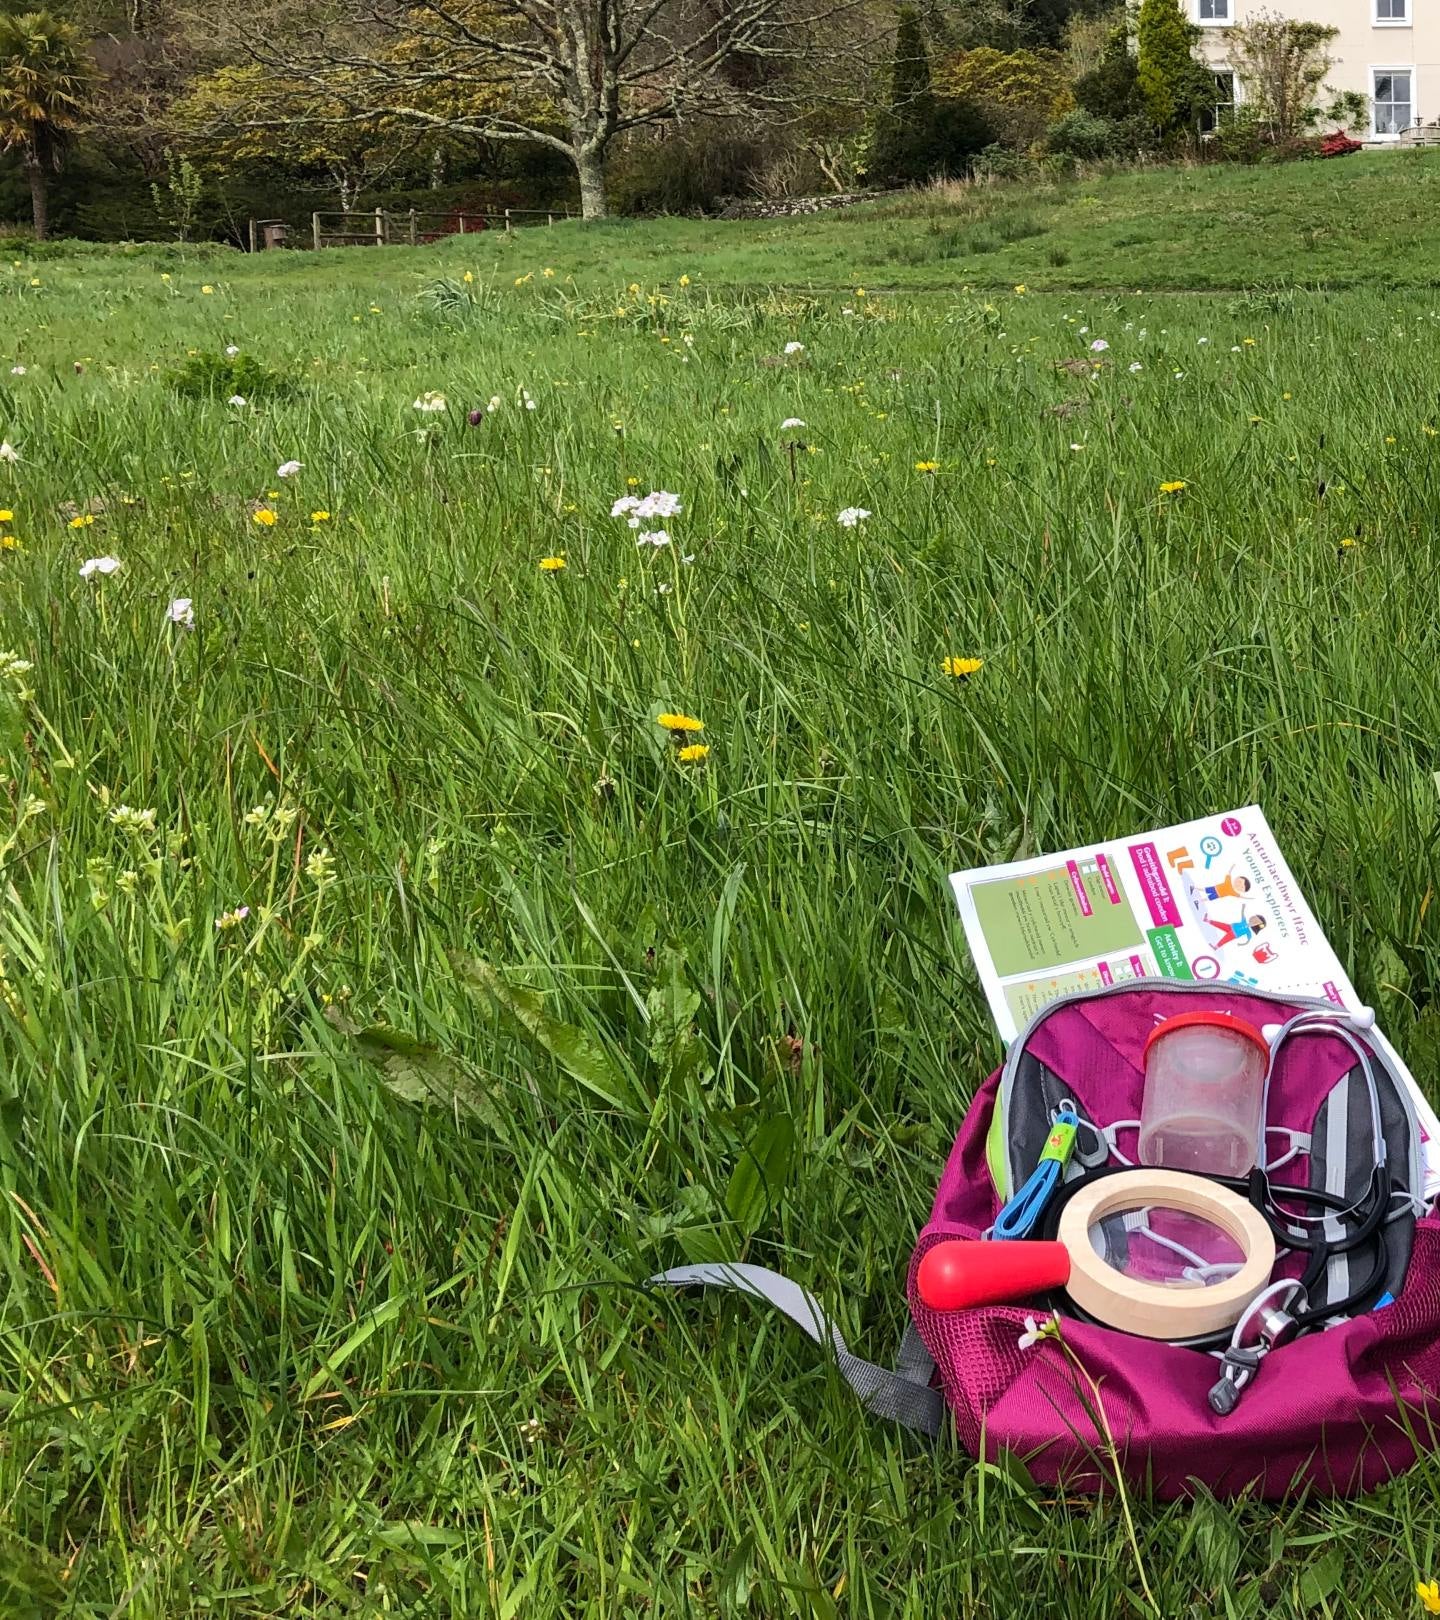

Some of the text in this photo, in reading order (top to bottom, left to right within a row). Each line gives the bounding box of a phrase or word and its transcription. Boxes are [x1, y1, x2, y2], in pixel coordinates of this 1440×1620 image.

[1135, 847, 1146, 864] Dod
[1241, 847, 1289, 937] Young Explorers
[1247, 834, 1309, 946] Anturiaethwyr Ifanc
[1154, 934, 1164, 948] Get
[1160, 948, 1167, 957] to
[1164, 932, 1180, 960] Activity
